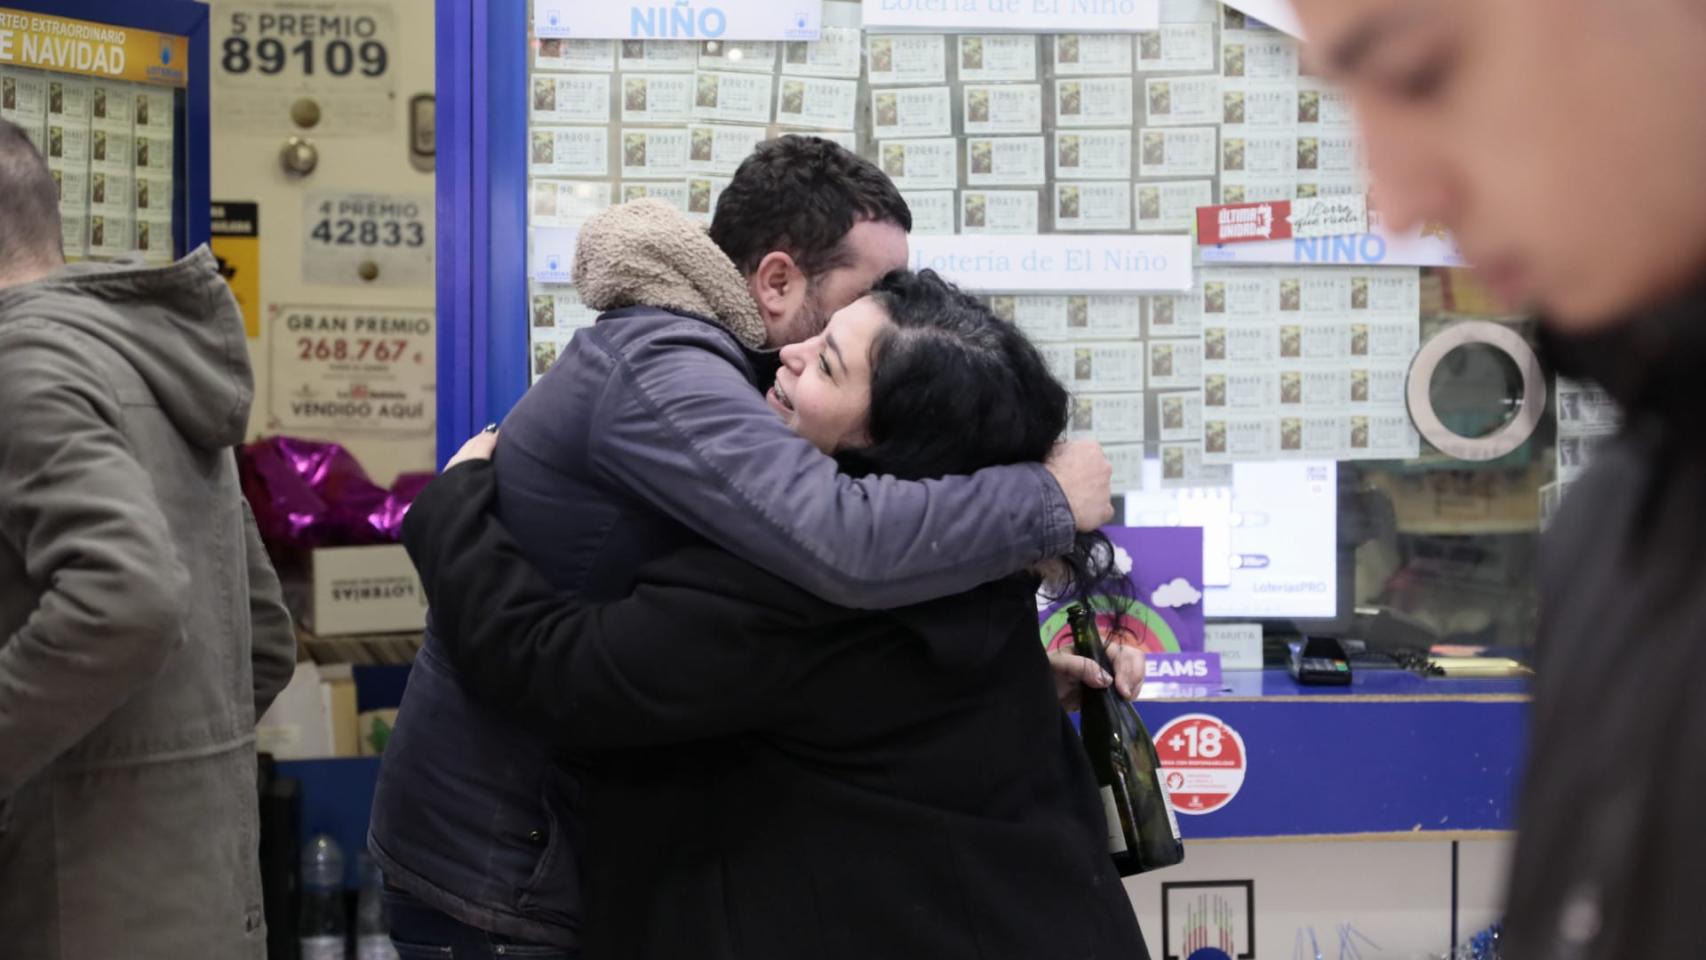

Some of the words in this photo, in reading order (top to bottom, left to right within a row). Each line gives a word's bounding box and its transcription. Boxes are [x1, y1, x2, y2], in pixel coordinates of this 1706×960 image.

[0, 14, 29, 33] RTEO
[32, 17, 127, 45] EXTRAORDINARIO
[259, 13, 378, 37] PREMIO
[630, 0, 728, 38] NIÑO
[0, 29, 14, 61] E
[21, 32, 125, 74] NAVIDAD
[222, 37, 389, 78] 89109
[339, 201, 419, 218] PREMIO
[311, 218, 425, 247] 42833
[1021, 247, 1055, 272] de
[1064, 247, 1094, 272] El
[1103, 247, 1168, 273] Niño
[287, 315, 347, 332] GRAN
[355, 317, 430, 335] PREMIO
[297, 337, 408, 362] 268.767
[291, 401, 372, 418] VENDIDO
[1145, 659, 1208, 679] EAMS
[1168, 726, 1223, 759] +18
